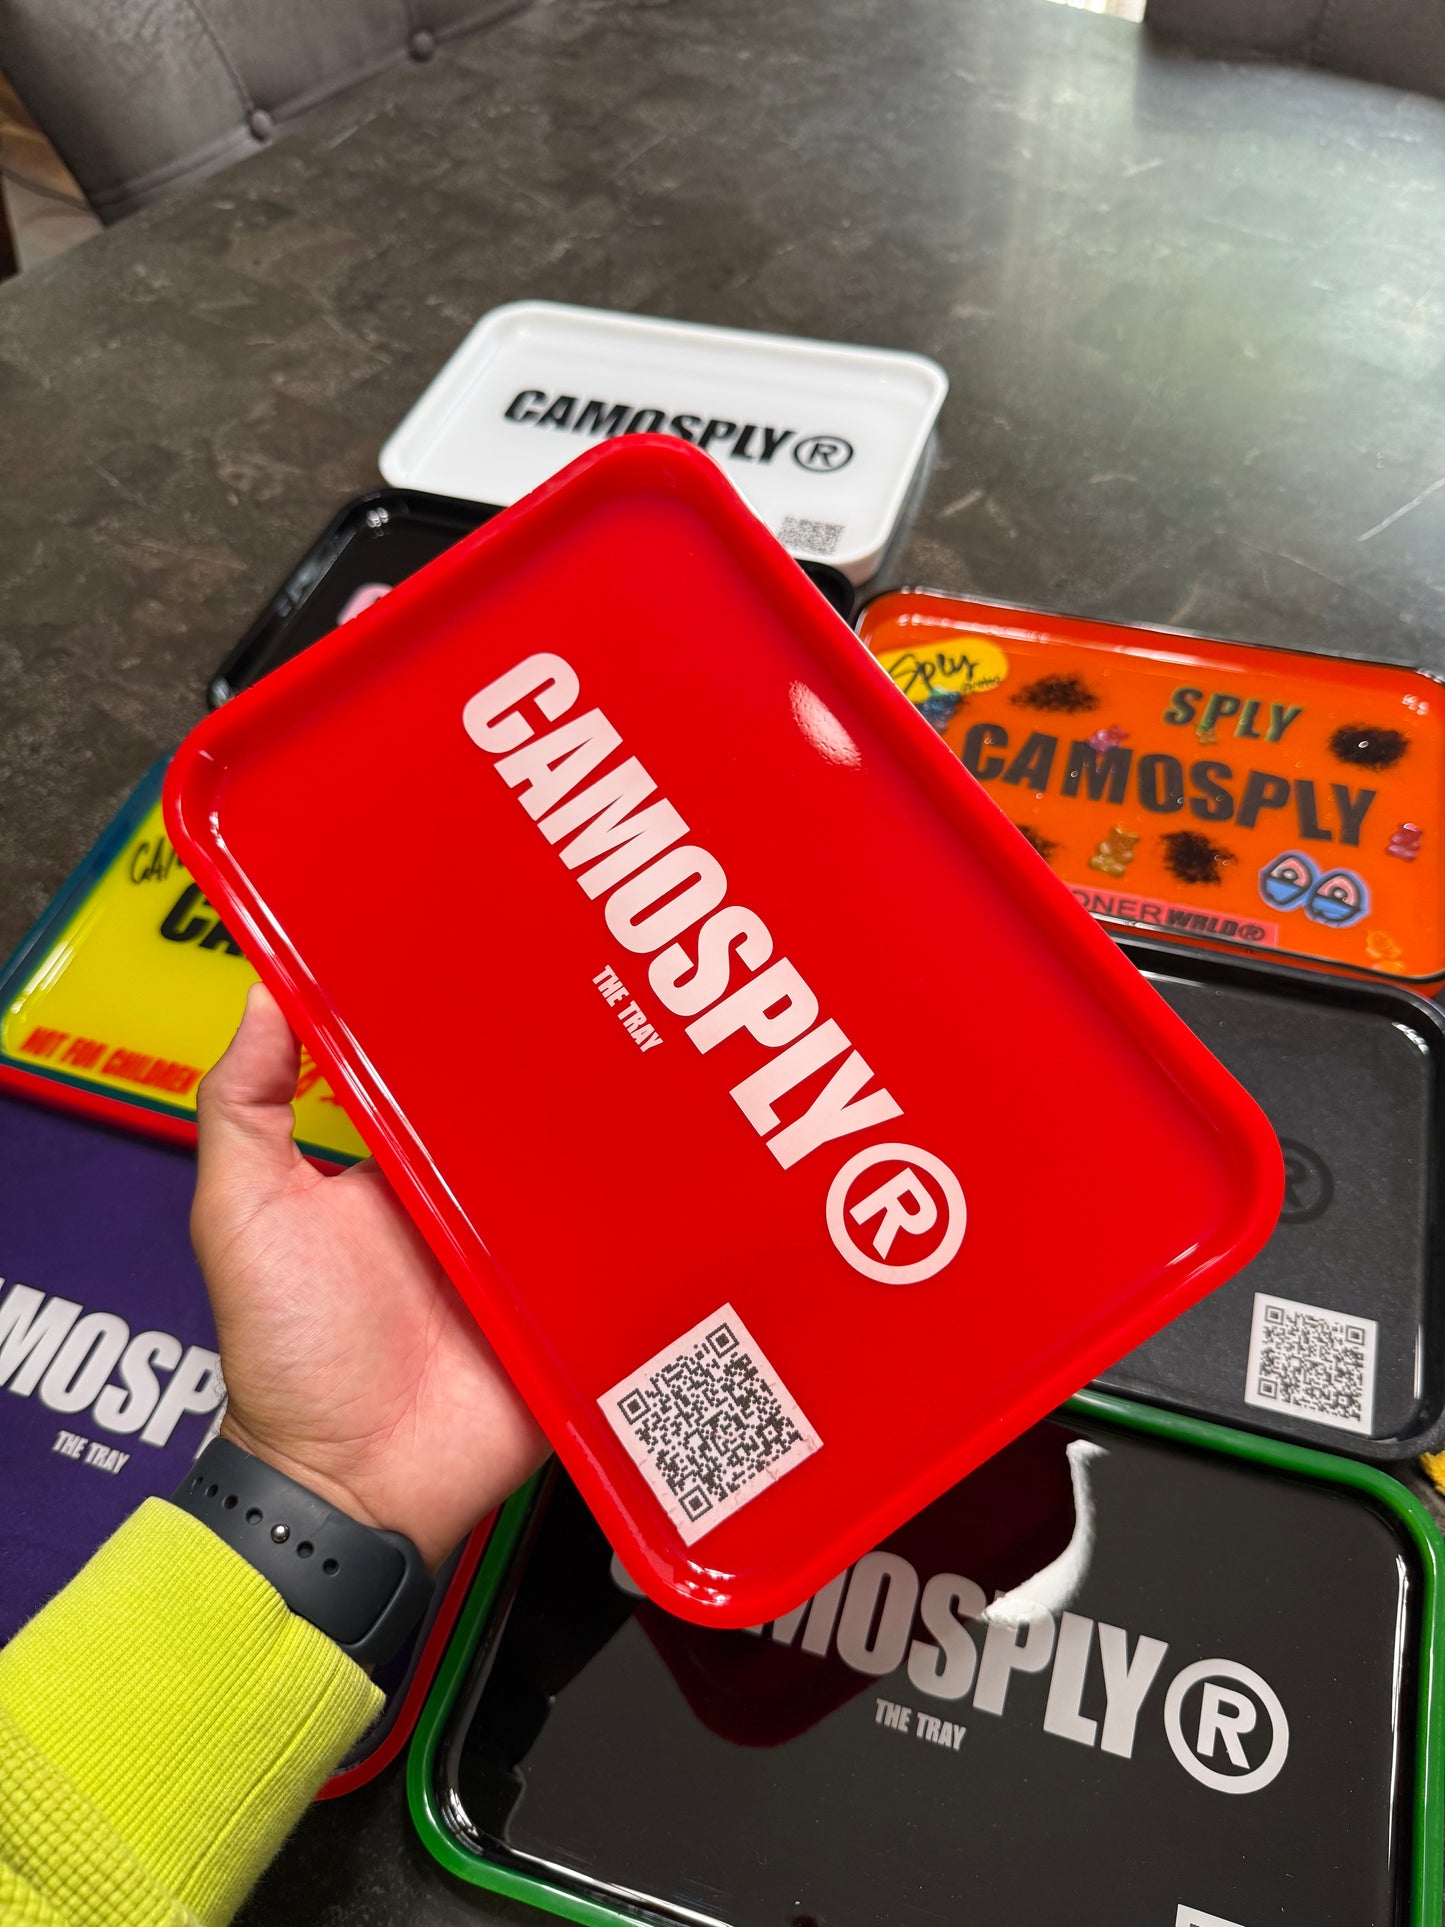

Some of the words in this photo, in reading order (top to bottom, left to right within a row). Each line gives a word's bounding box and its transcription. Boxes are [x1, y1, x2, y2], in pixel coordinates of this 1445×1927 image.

[1162, 686, 1302, 743] SPLY
[961, 722, 1377, 848] CAMOSPLY
[592, 964, 630, 1008] THE
[617, 1000, 664, 1053] TRAY
[0, 1277, 228, 1460] MOSP
[52, 1430, 89, 1460] THE
[84, 1442, 131, 1475] TRAY
[875, 1698, 912, 1733] THE
[916, 1711, 967, 1752] TRAY
